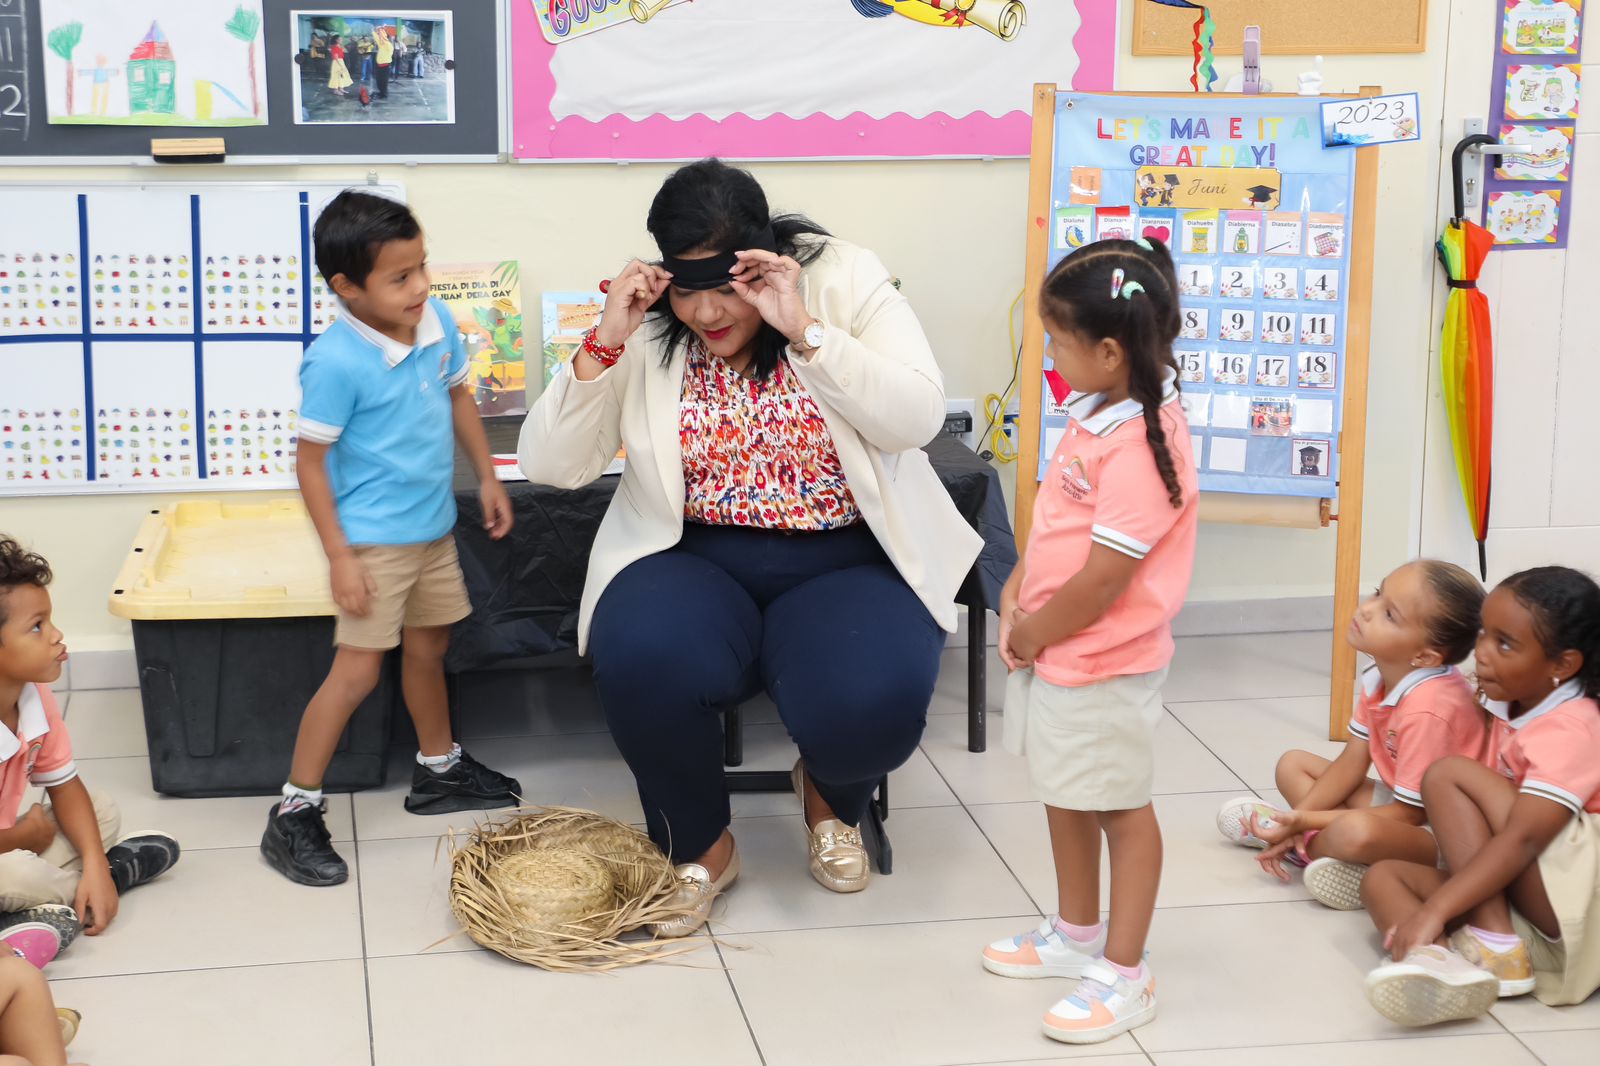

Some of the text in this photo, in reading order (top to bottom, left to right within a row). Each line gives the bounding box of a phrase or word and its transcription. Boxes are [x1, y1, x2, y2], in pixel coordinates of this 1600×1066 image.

[0, 84, 27, 117] 2
[1337, 101, 1405, 124] 2023
[1097, 115, 1162, 141] LET'S
[1257, 117, 1283, 141] IT
[1291, 117, 1311, 140] A
[1130, 143, 1276, 166] GREAT DAY!
[1187, 178, 1227, 196] Juni
[430, 280, 499, 291] FIESTA DI DIA DI
[1190, 270, 1199, 287] 1
[1230, 271, 1243, 288] 2
[1273, 272, 1286, 290] 3
[1314, 274, 1328, 291] 4
[492, 290, 512, 298] GAY
[1185, 311, 1198, 328] 8
[1231, 312, 1244, 330] 9
[1267, 315, 1291, 333] 10
[1308, 317, 1326, 334] 11
[1178, 352, 1200, 372] 15
[1221, 356, 1244, 374] 16
[1262, 359, 1284, 376] 17
[1304, 356, 1327, 373] 18
